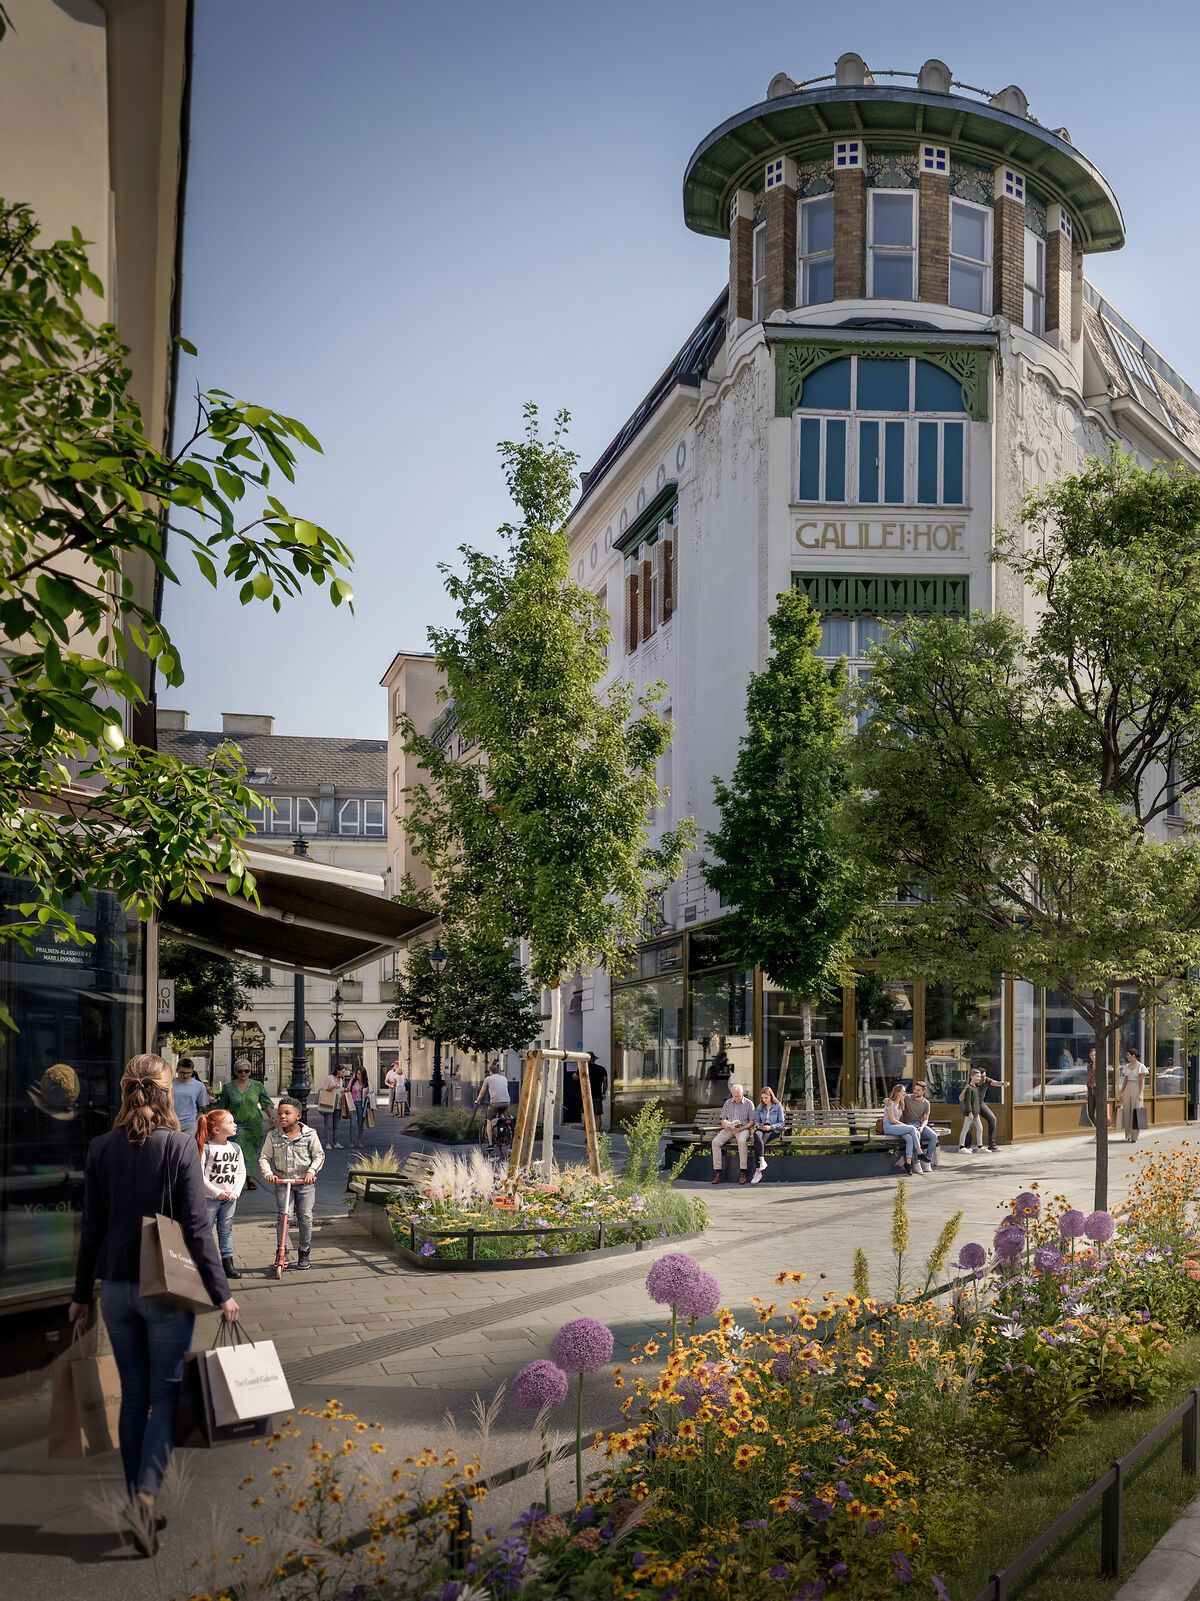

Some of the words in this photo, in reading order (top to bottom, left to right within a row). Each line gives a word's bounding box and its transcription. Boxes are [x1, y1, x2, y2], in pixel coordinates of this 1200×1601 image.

[213, 1151, 239, 1163] LOVE
[211, 1163, 238, 1174] NEW
[209, 1174, 236, 1185] YORK
